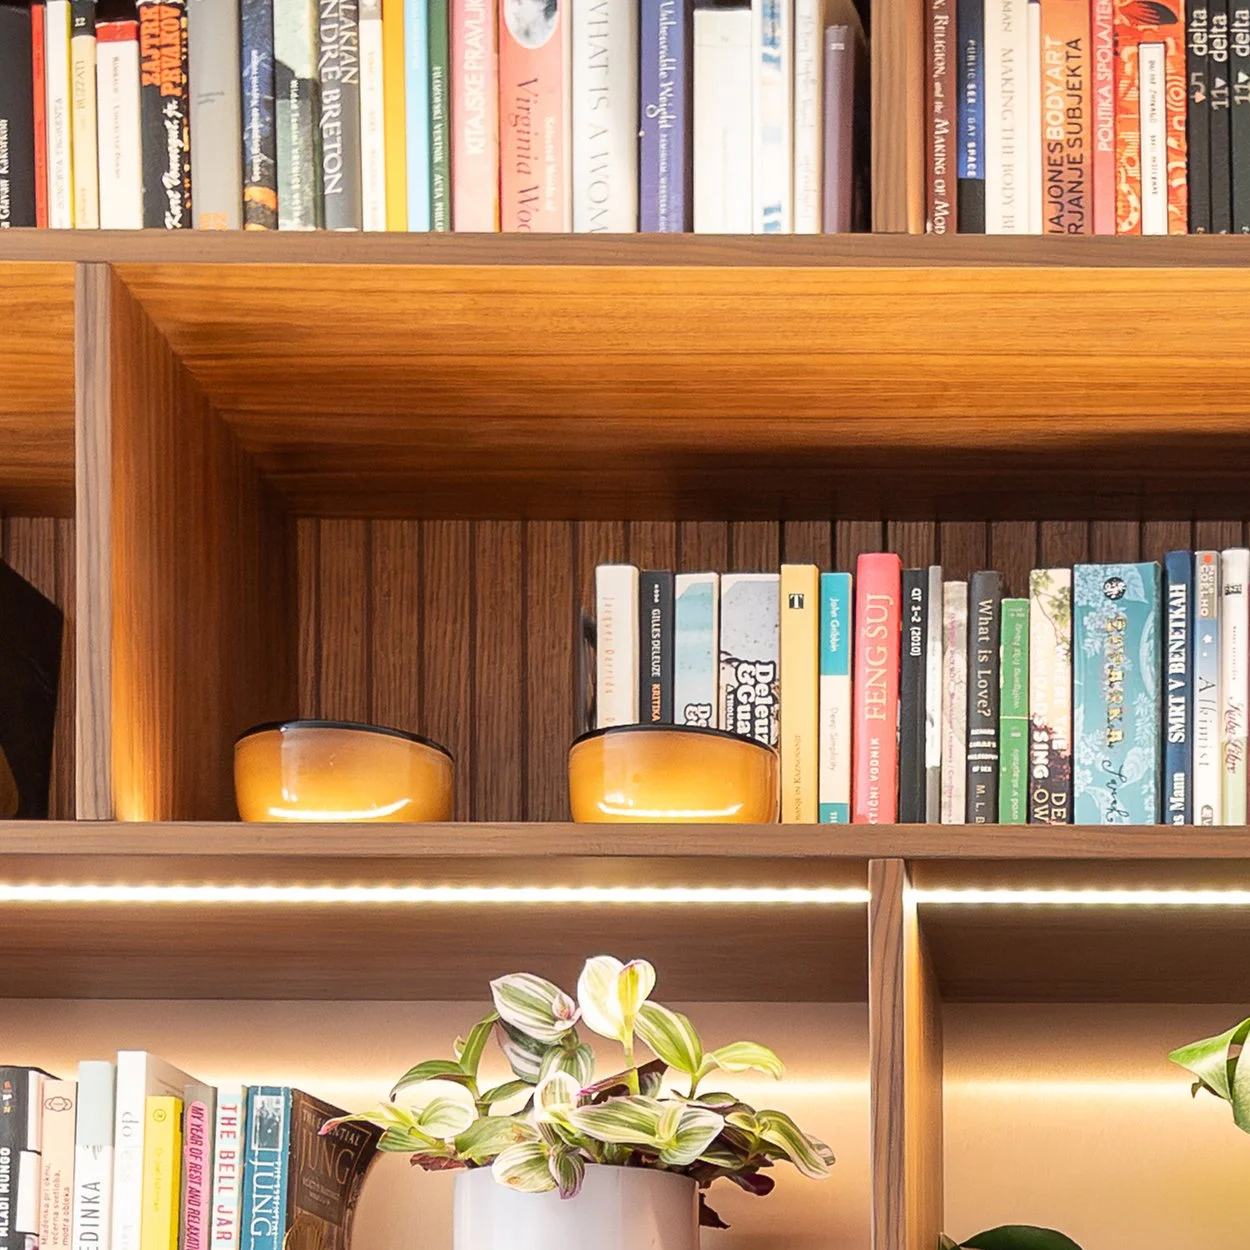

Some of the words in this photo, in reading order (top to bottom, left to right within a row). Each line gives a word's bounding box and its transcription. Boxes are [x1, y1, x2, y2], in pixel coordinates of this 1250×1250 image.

[141, 5, 161, 87] ZAJTRK
[161, 6, 182, 96] PRVAKOV
[658, 1, 677, 79] Unbearable
[1188, 8, 1208, 57] delta
[1209, 14, 1228, 62] delta
[1231, 9, 1250, 57] delta
[464, 73, 486, 155] KITAJSKE
[588, 88, 610, 111] IS
[646, 82, 674, 129] Weight
[1065, 37, 1083, 149] SUBJEKTA
[319, 88, 342, 195] BRETON
[511, 78, 539, 175] Virginia
[588, 122, 610, 142] A
[1096, 85, 1113, 152] POLITIKA
[933, 118, 951, 174] MAKING
[1000, 163, 1016, 206] BODY
[1199, 562, 1209, 617] COELHO
[909, 626, 922, 657] (2010)
[976, 598, 993, 644] What
[1168, 583, 1187, 676] BENETKAH
[977, 650, 992, 663] is
[863, 649, 887, 721] FENG
[976, 669, 992, 717] Love?
[1169, 681, 1186, 696] V
[1168, 698, 1186, 744] SMRT
[1197, 675, 1216, 767] Alkimist
[869, 737, 881, 778] VODNIK
[1032, 731, 1050, 779] SING
[1172, 772, 1185, 812] Mann
[189, 1123, 203, 1146] YEAR
[190, 1105, 204, 1122] MY
[219, 1104, 238, 1139] THE
[188, 1162, 202, 1188] REST
[189, 1147, 202, 1161] OF
[217, 1150, 235, 1193] BELL
[187, 1189, 201, 1208] AND
[249, 1159, 274, 1237] JUNG
[215, 1204, 233, 1241] JAR
